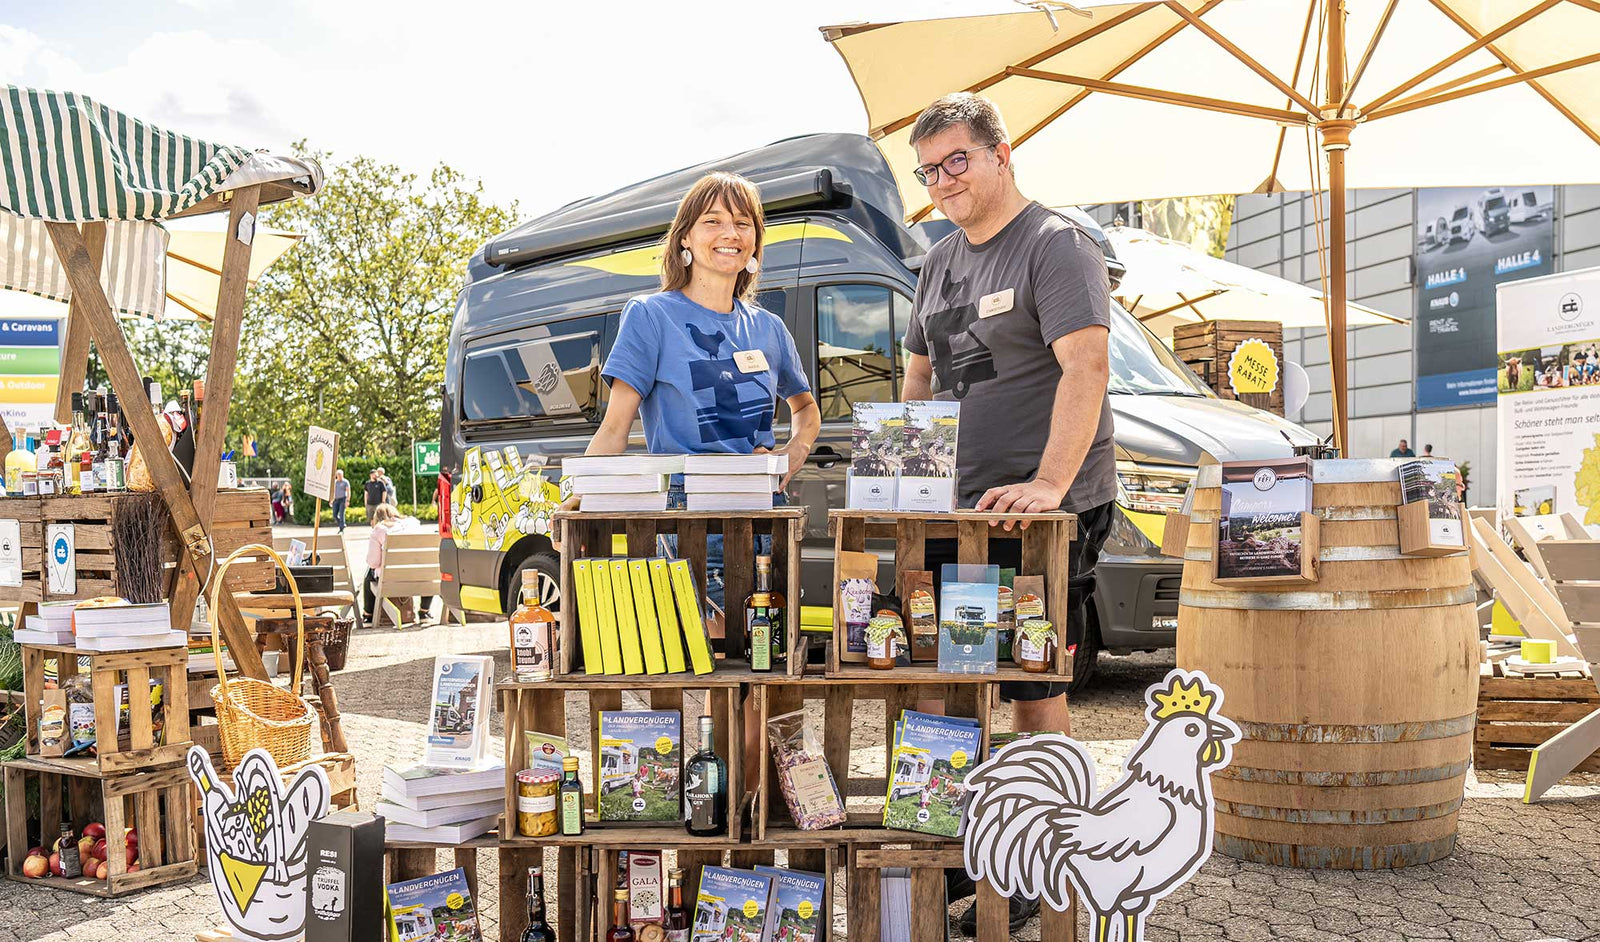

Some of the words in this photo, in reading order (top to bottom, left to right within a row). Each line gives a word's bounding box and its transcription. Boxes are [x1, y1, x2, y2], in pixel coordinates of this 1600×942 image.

[1497, 252, 1531, 270] HALLE
[1532, 249, 1540, 262] 4
[1428, 269, 1457, 285] HALLE
[1458, 267, 1465, 279] 1
[2, 323, 10, 332] &
[11, 322, 53, 332] Caravans
[1244, 355, 1268, 377] MESSE
[1237, 365, 1267, 390] RABATT
[1514, 419, 1542, 429] Schöner
[1544, 417, 1563, 426] steht
[1564, 416, 1583, 424] man
[1251, 511, 1299, 524] welcome!
[608, 716, 675, 724] LANDVERGNÜGEN
[911, 724, 975, 739] LANDVERGNÜGEN
[320, 850, 337, 858] RESI
[394, 873, 460, 894] LANDVERGNÜGEN
[632, 877, 658, 886] GALA
[707, 872, 765, 889] LANDVERGNÜGEN
